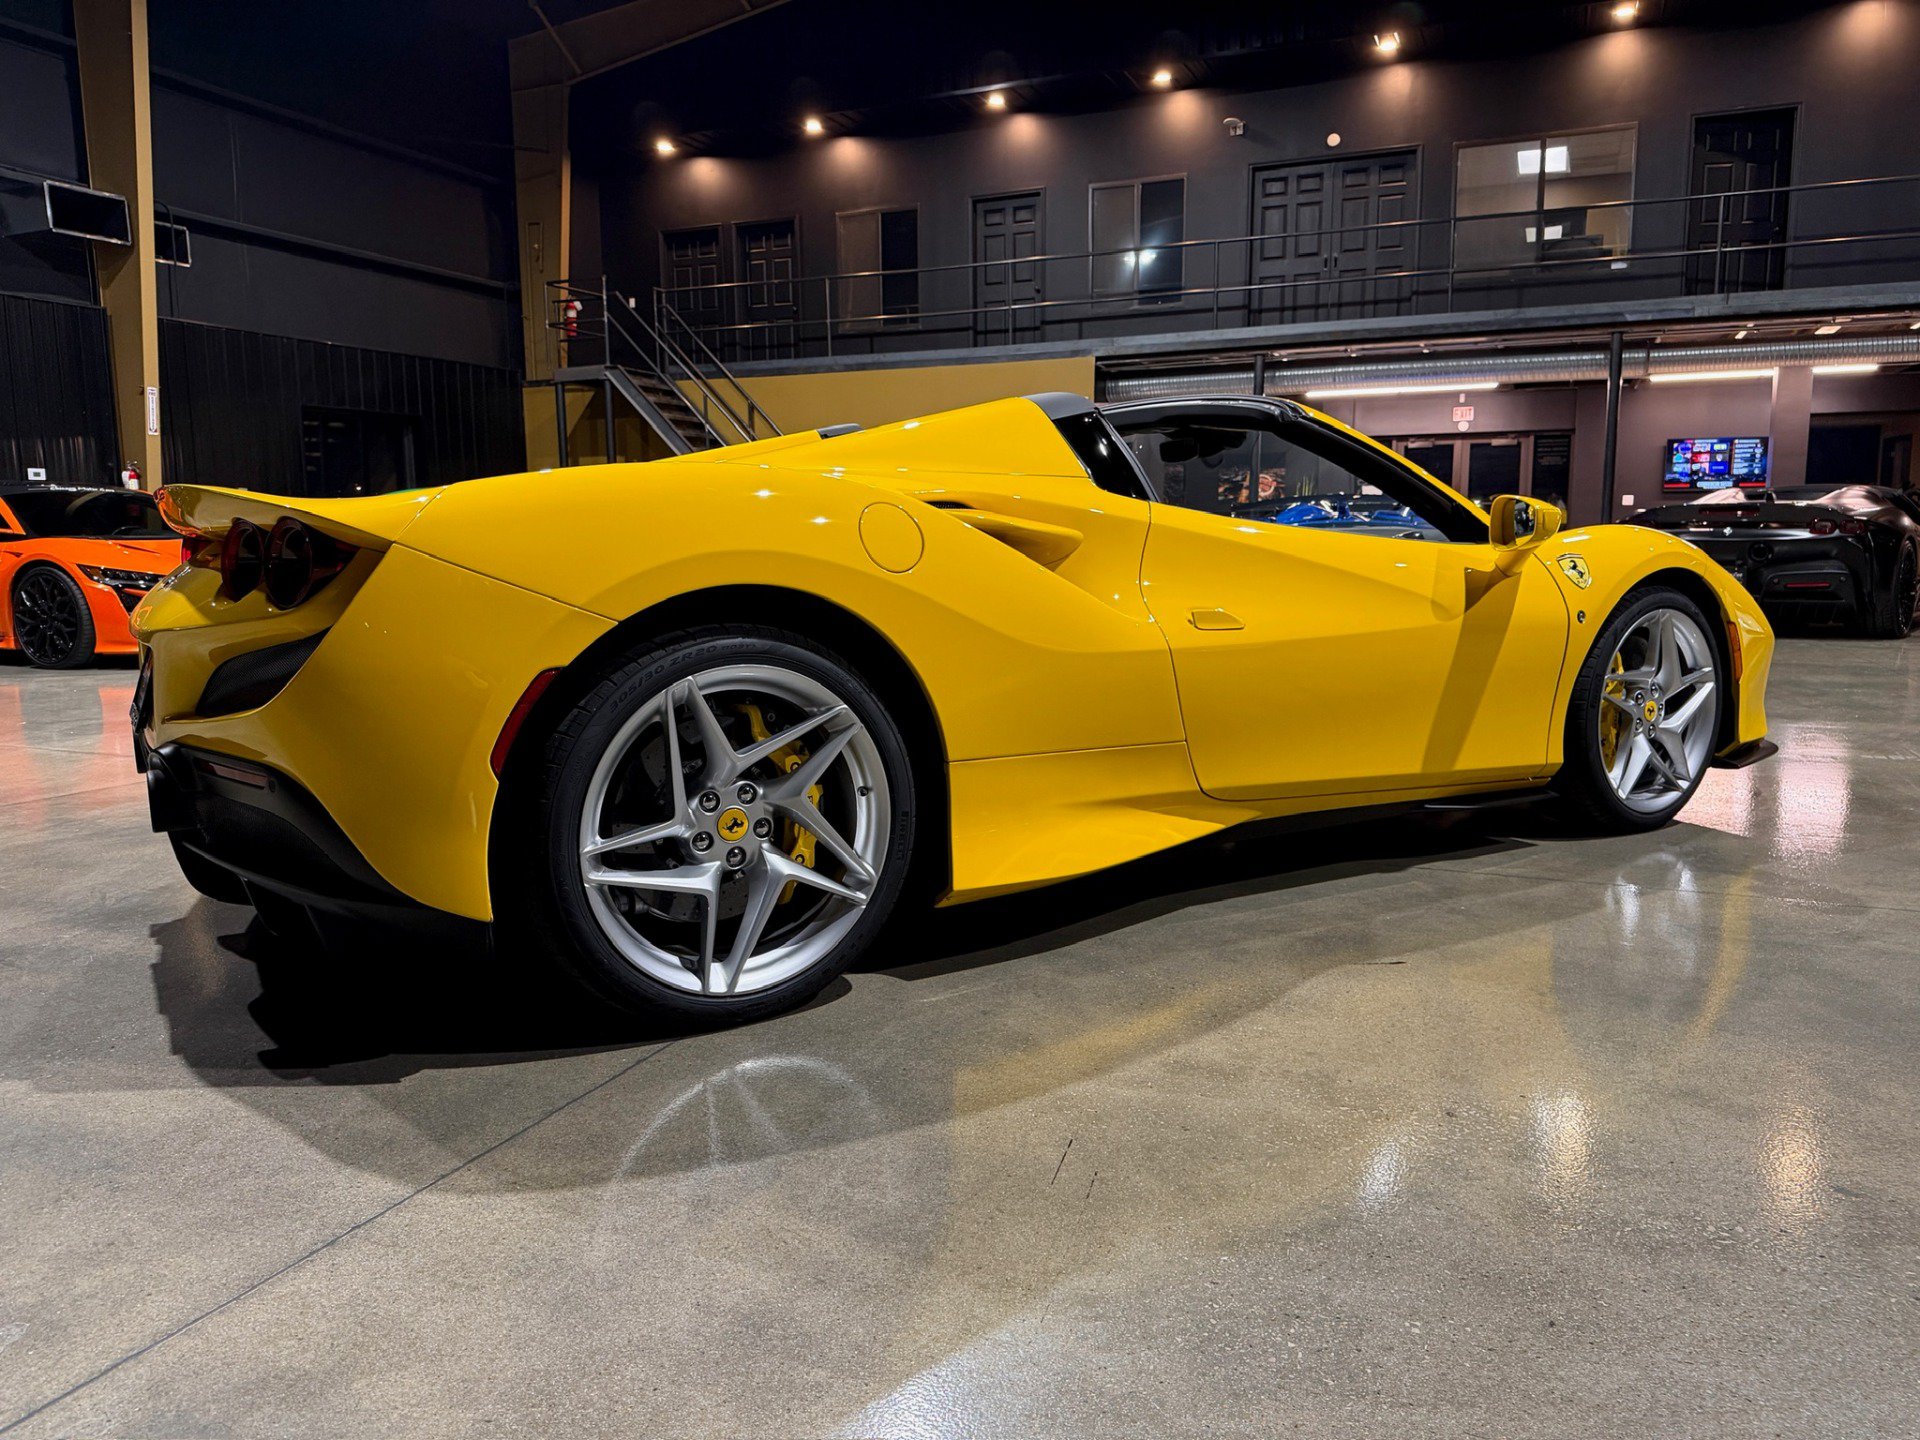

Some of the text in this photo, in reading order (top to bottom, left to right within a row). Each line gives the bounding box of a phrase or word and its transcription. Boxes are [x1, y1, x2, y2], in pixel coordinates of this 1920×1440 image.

[1454, 408, 1472, 418] EXIT
[608, 664, 666, 714] 305/30
[669, 645, 717, 666] ZR20
